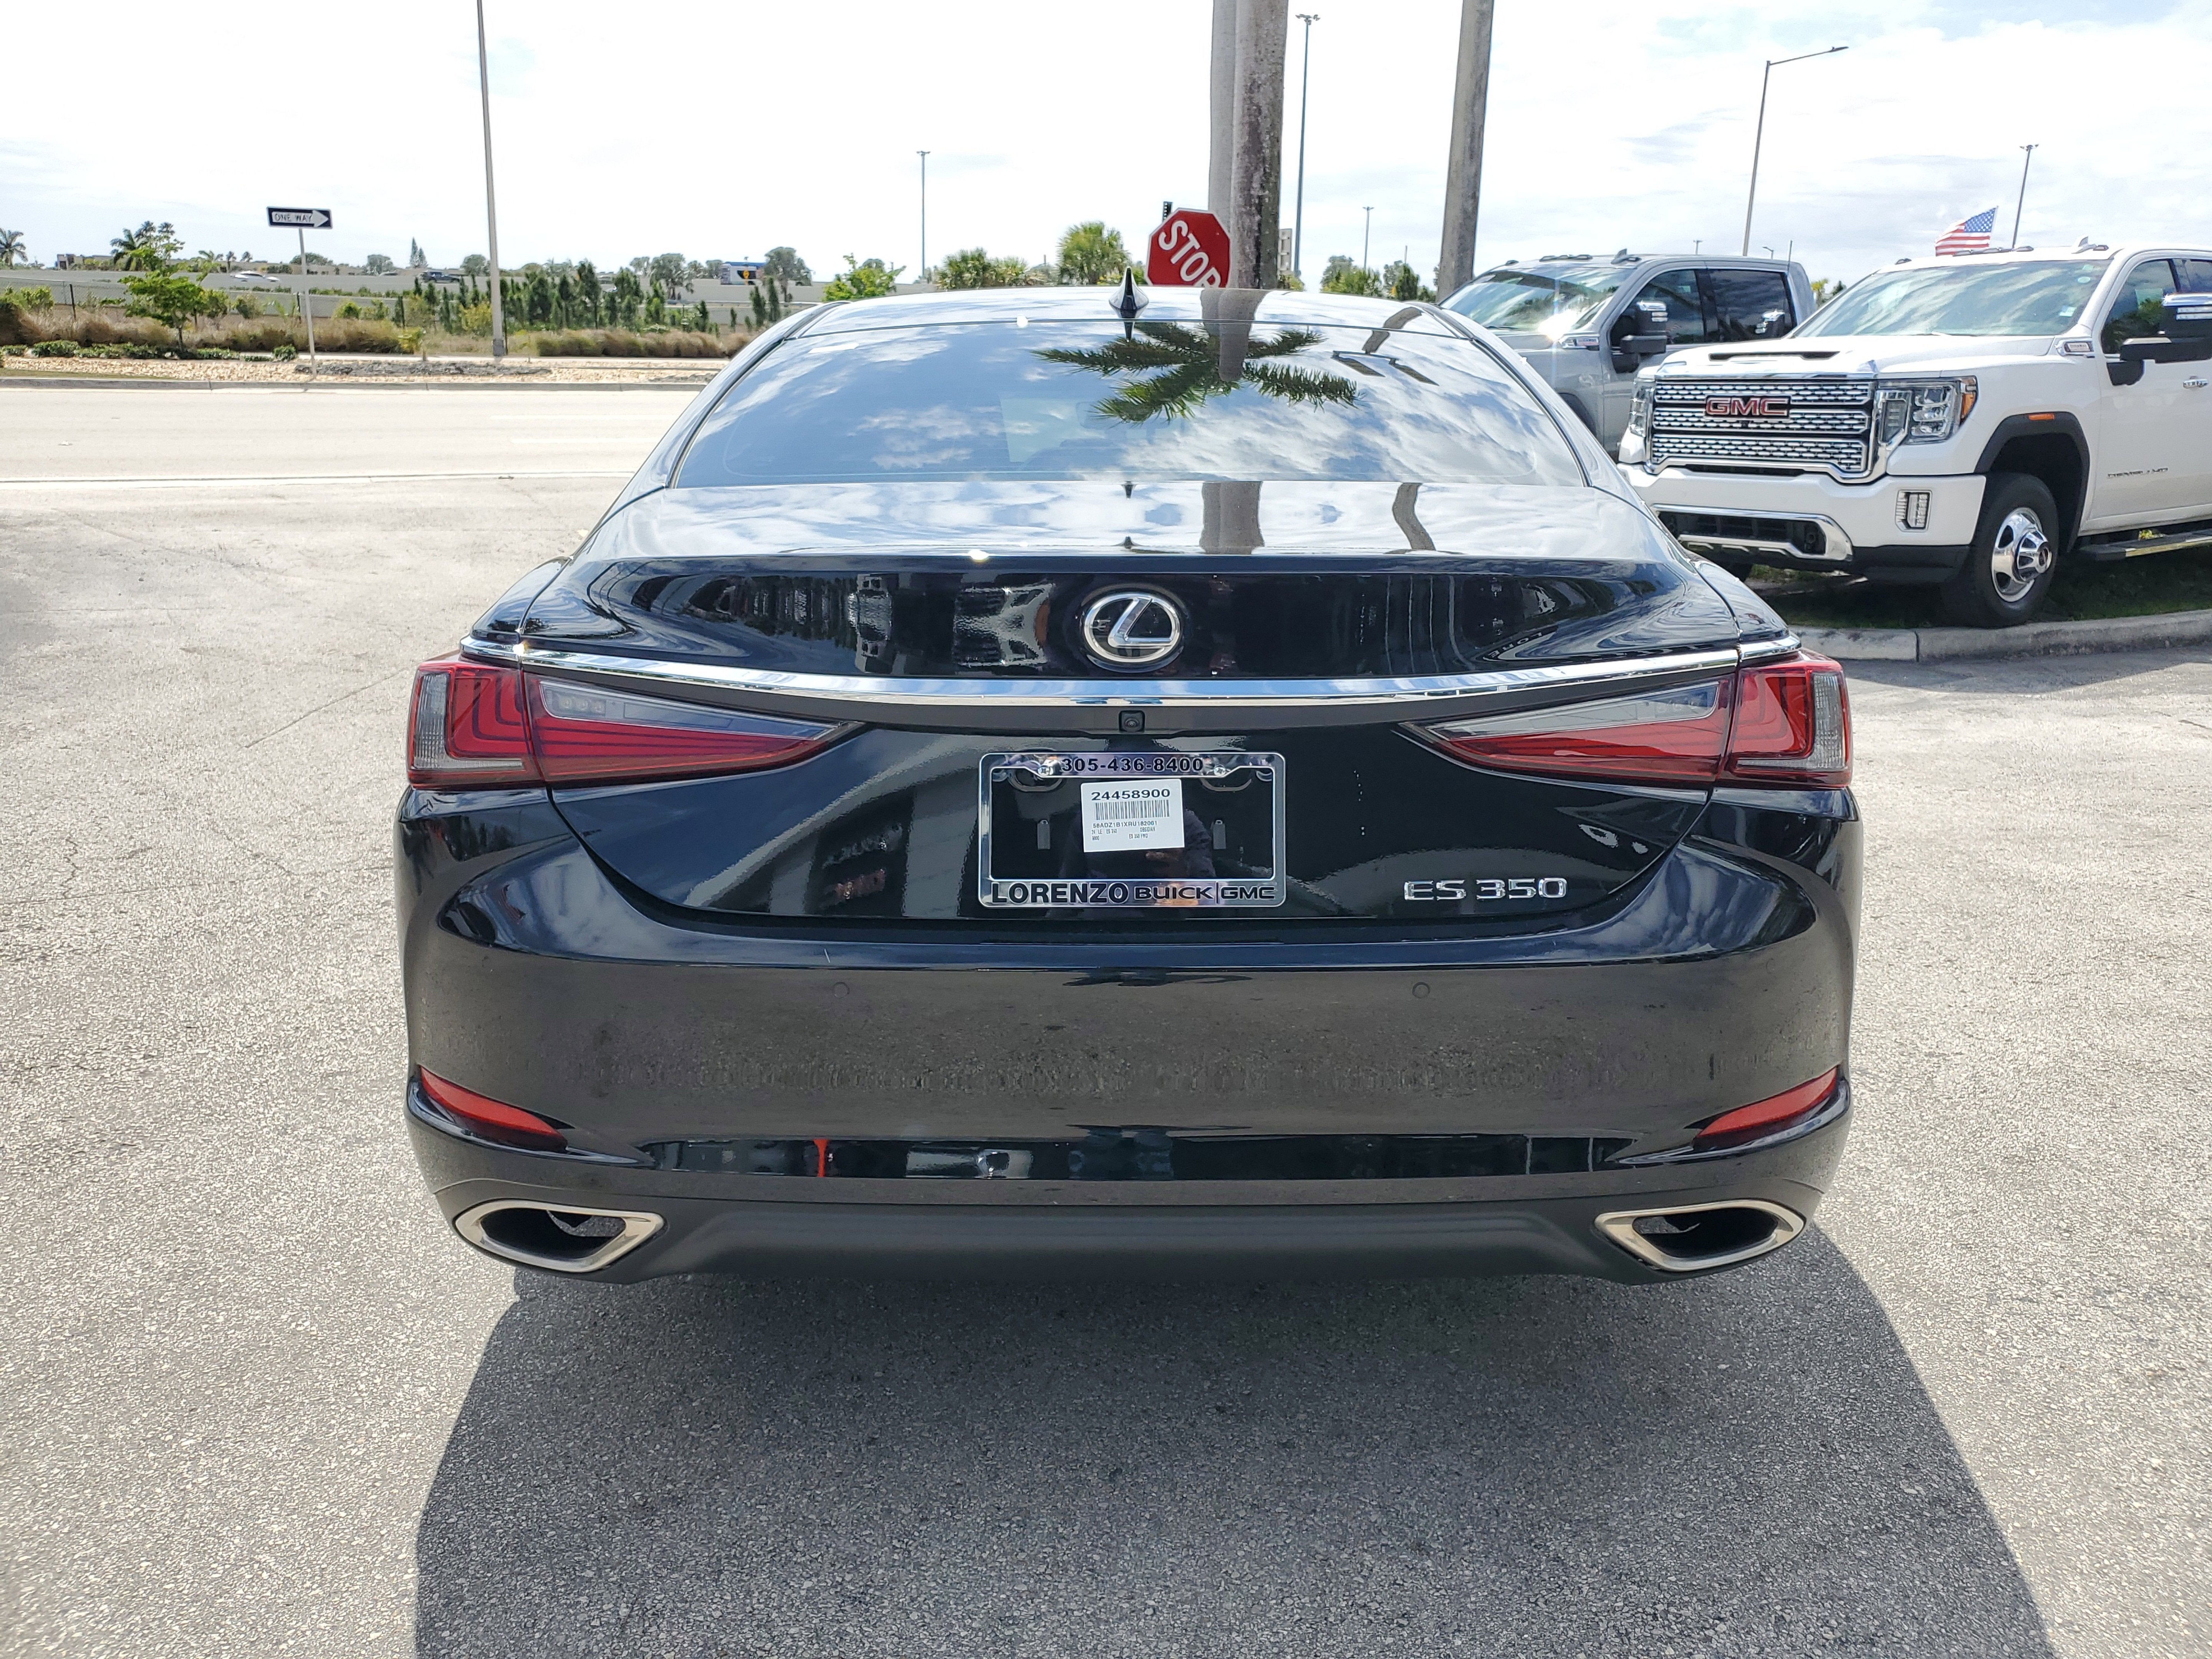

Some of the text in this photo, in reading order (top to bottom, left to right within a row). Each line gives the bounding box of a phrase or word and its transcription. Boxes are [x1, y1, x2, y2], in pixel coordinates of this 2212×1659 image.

[1158, 220, 1221, 287] STOP
[1706, 397, 1789, 416] GMC
[1061, 758, 1204, 772] 305-436-8400
[1091, 788, 1171, 801] 24458900
[991, 882, 1275, 904] LORENZO BUICK GMC
[1404, 877, 1568, 901] ES 350
